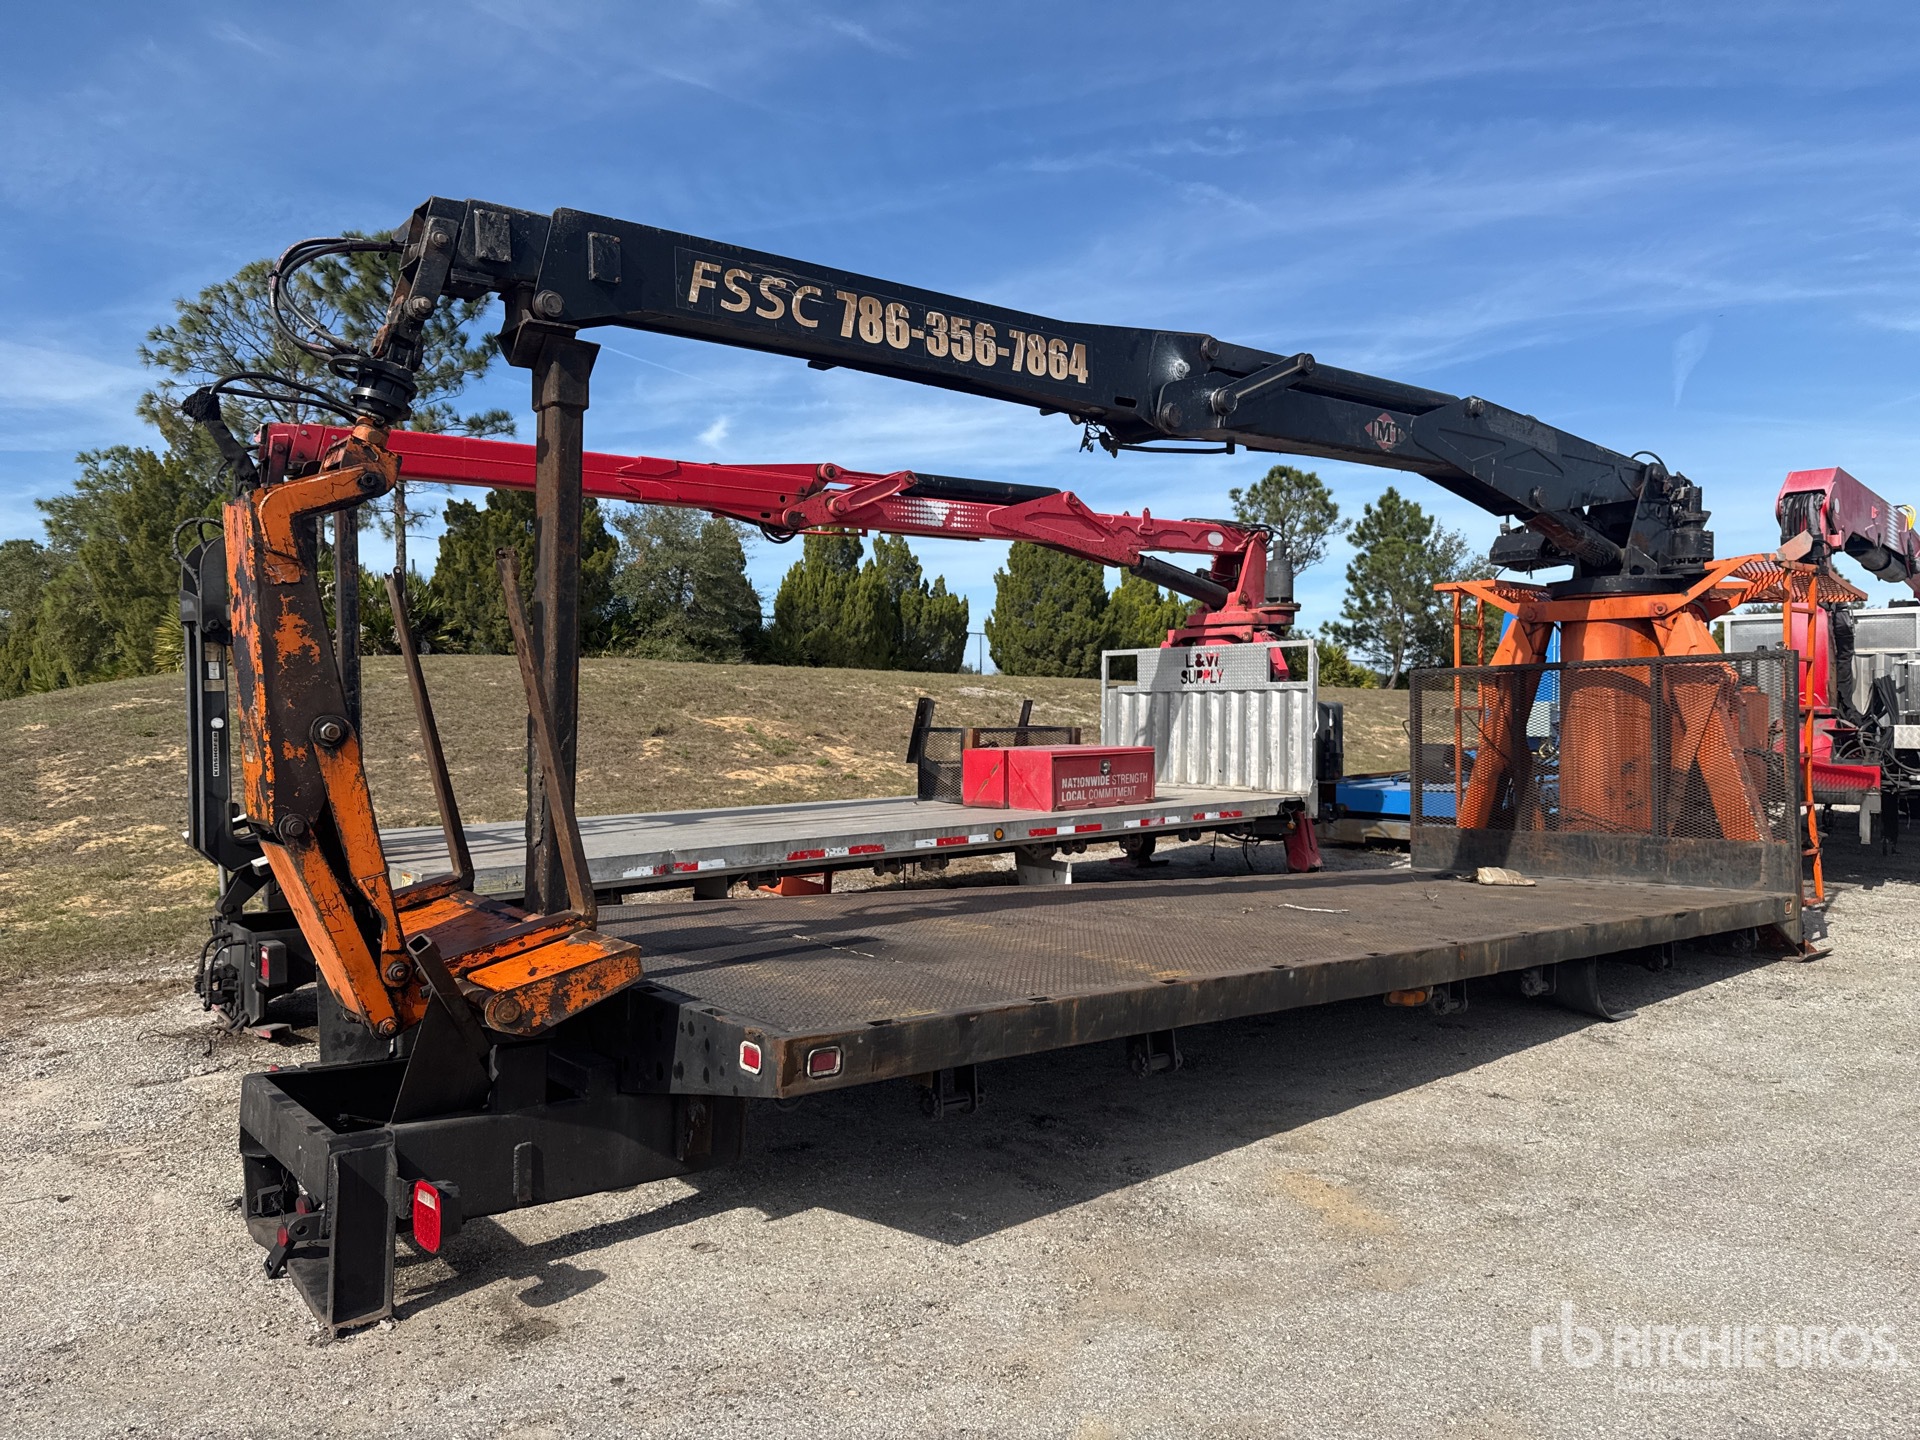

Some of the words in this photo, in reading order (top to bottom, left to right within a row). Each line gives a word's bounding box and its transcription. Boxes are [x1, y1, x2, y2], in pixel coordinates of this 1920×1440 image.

[688, 260, 823, 328] FSSC
[836, 289, 1089, 384] 786-356-7864
[1185, 653, 1220, 668] L&W
[1180, 669, 1224, 684] SUPPLY
[1061, 775, 1110, 789] NATIONWIDE
[1111, 772, 1148, 785] STRENGTH
[1061, 791, 1087, 802] LOCAL
[1088, 786, 1137, 800] COMMITMENT
